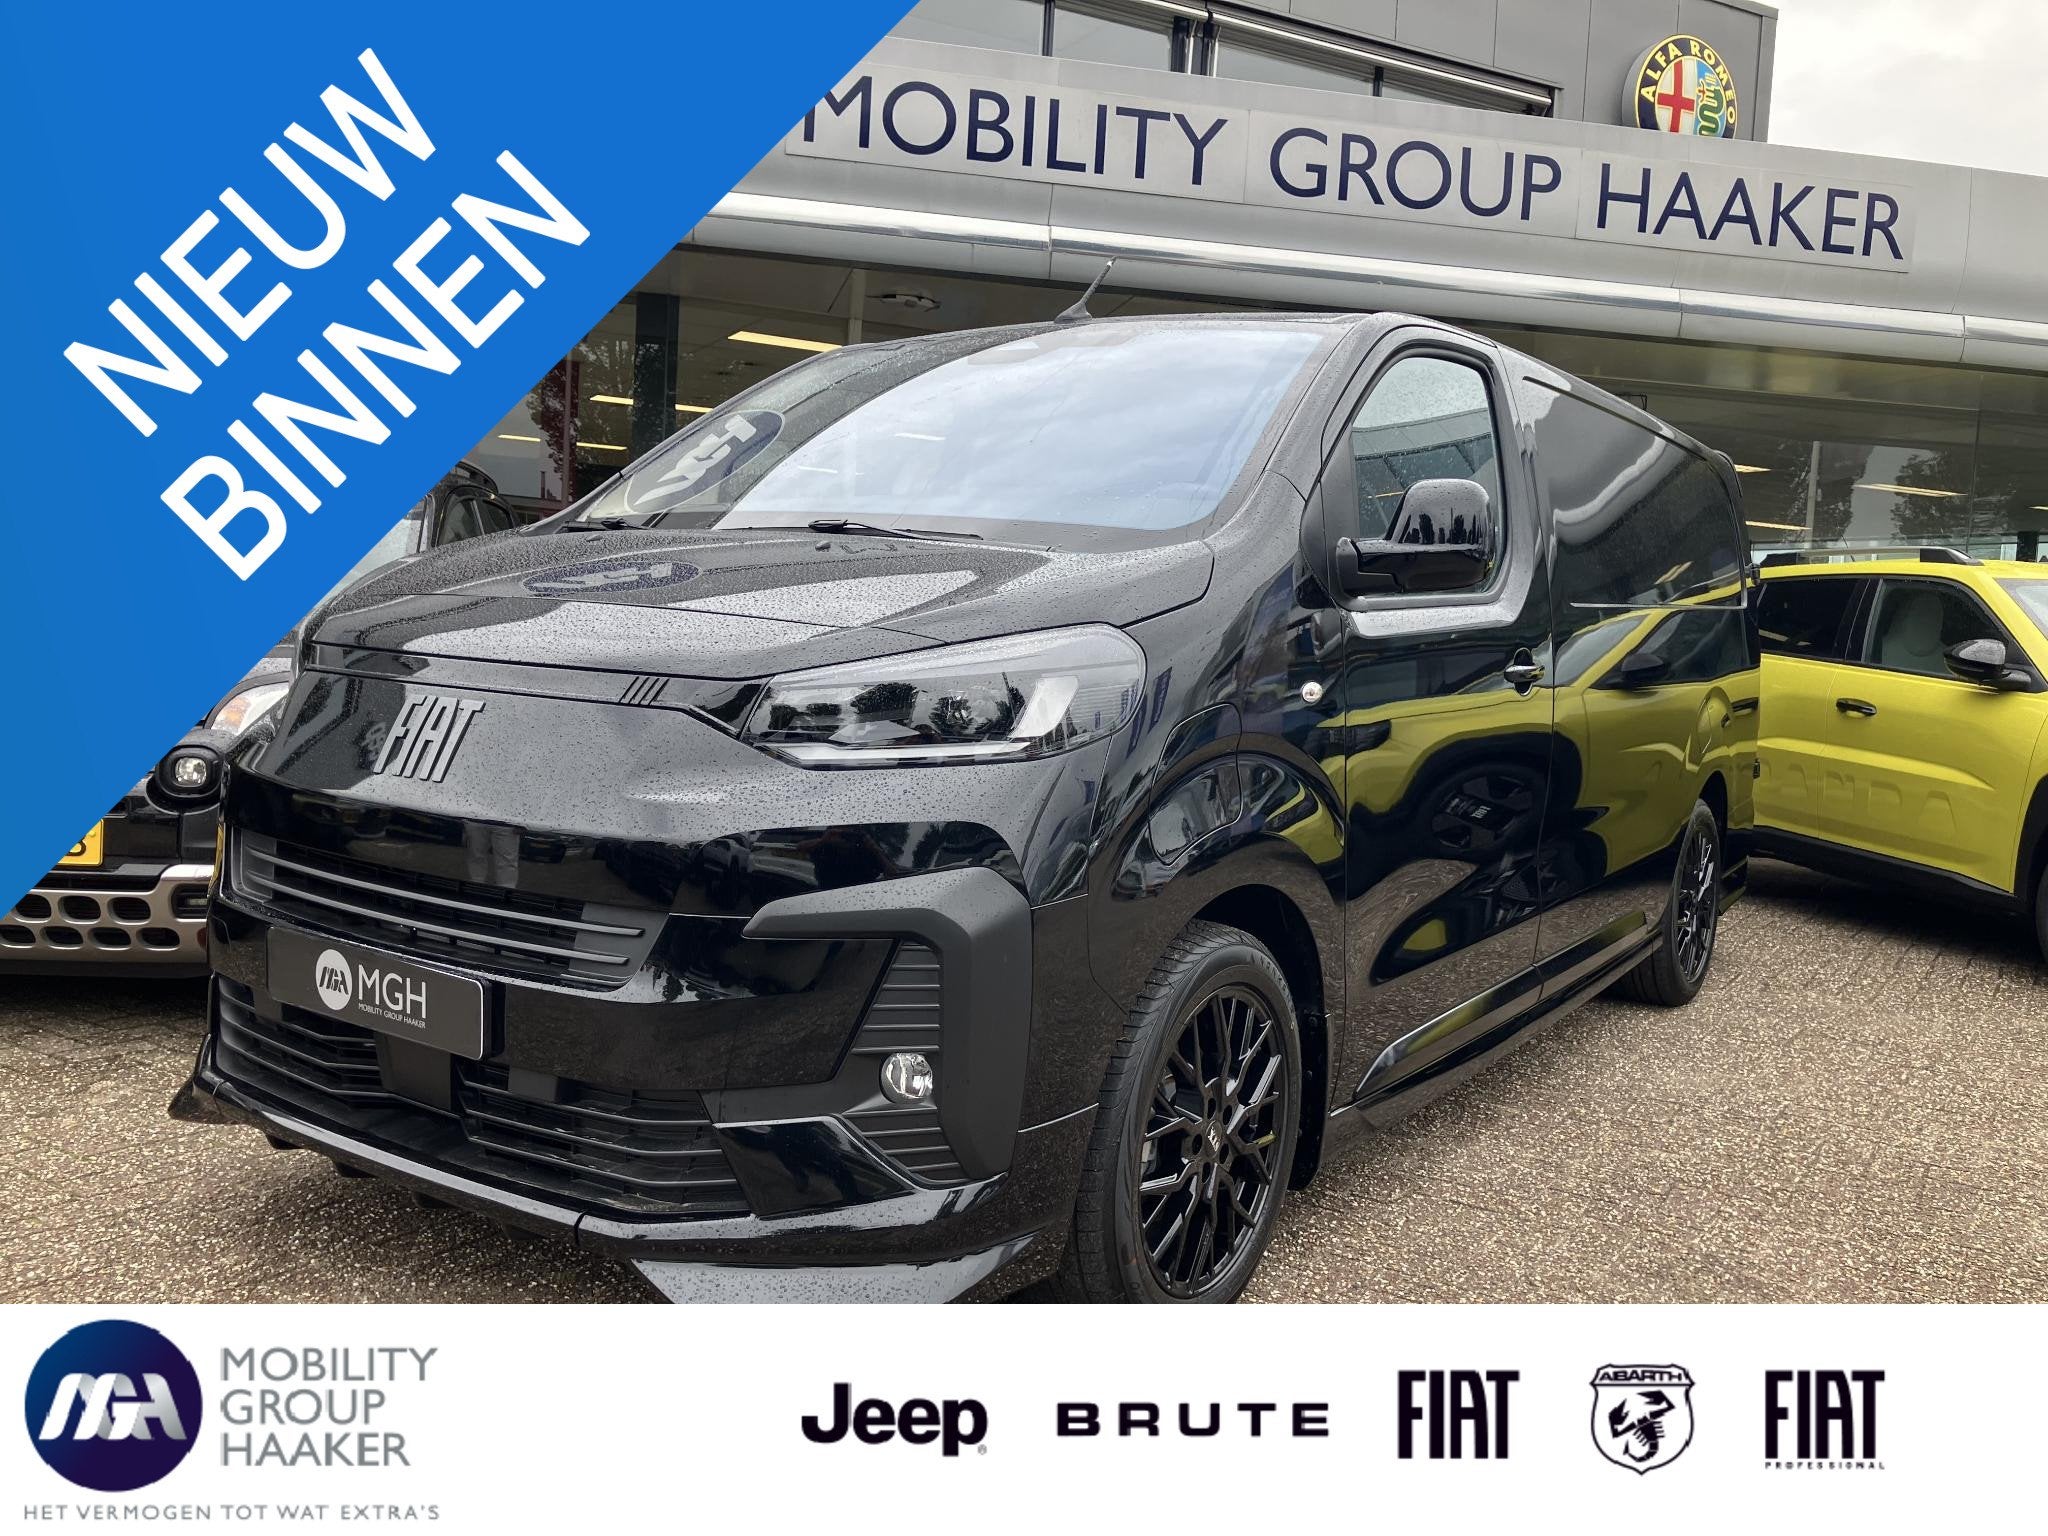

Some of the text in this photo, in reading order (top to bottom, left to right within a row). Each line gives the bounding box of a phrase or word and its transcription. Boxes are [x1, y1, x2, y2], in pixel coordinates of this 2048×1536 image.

[1640, 39, 1735, 124] ALFA ROMEO
[802, 75, 1904, 260] MOBILITY GROUP HAAKER
[373, 695, 486, 783] FIAT
[358, 964, 426, 1018] MGH
[358, 1002, 426, 1029] MOBILITY GROUP HAAKER
